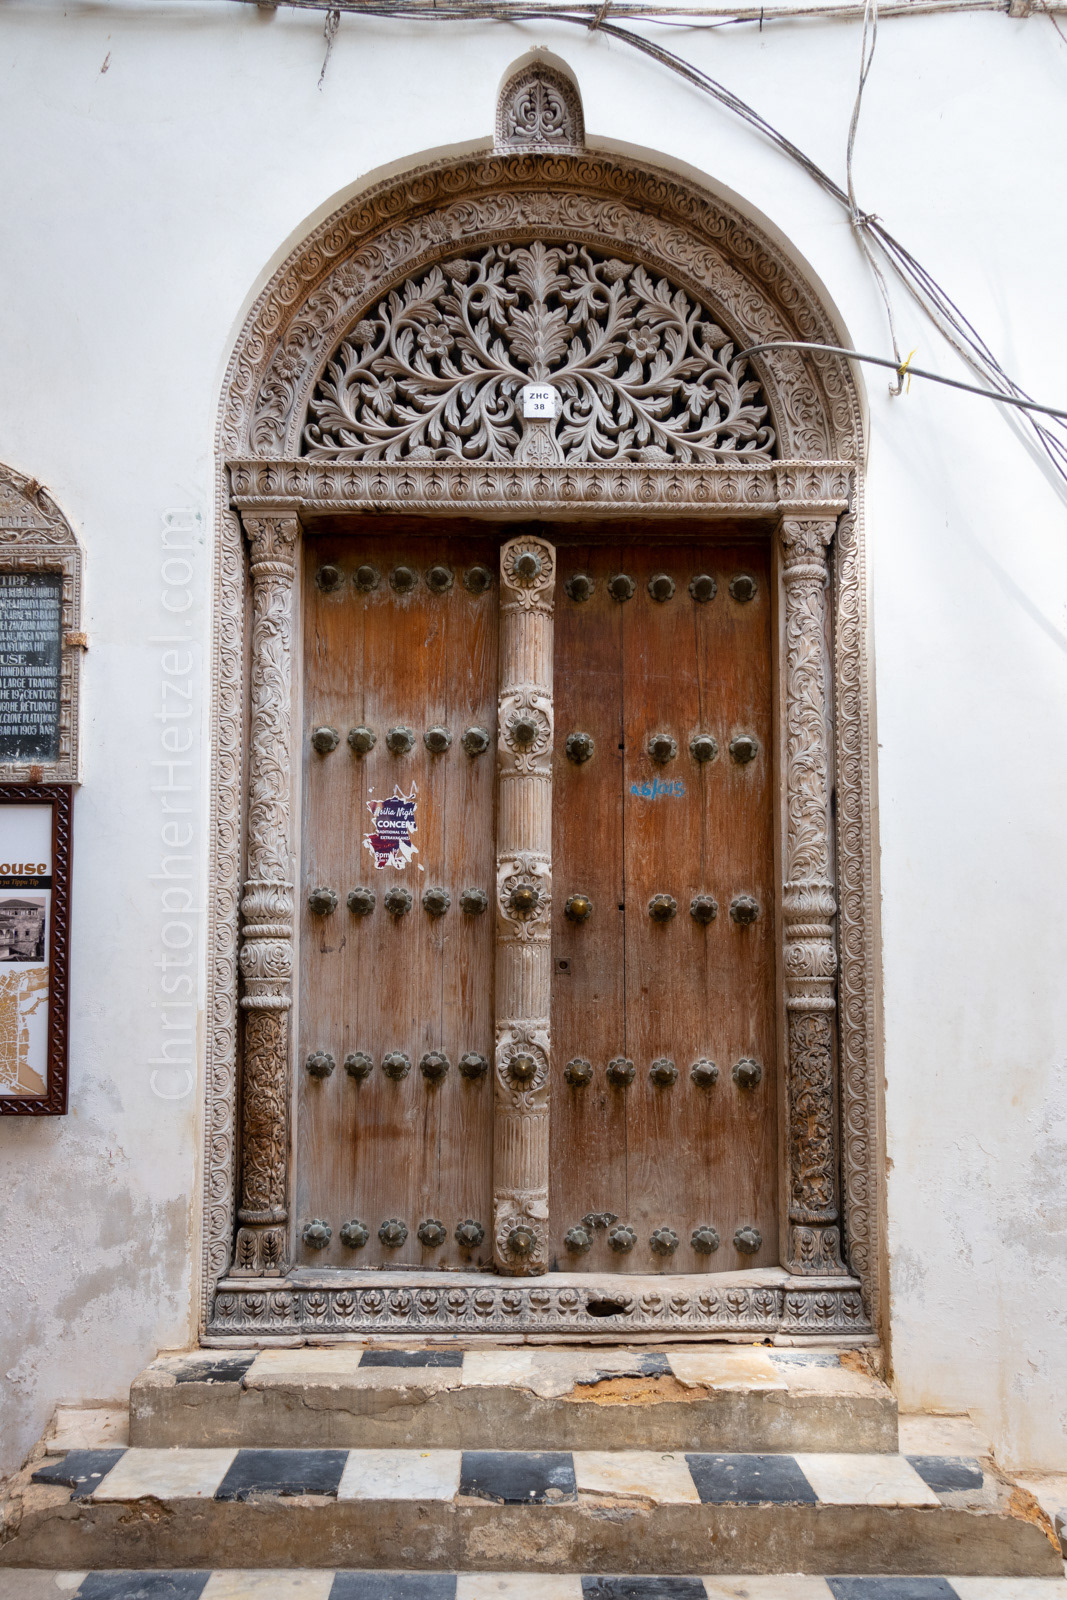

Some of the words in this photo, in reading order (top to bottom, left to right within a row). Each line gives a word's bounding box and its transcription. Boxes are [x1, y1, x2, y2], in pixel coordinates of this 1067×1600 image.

[529, 392, 549, 400] ZHC
[534, 403, 545, 411] 38
[3, 678, 27, 688] LARGE
[28, 678, 58, 688] TRADING
[24, 690, 58, 700] CENTURY
[20, 702, 57, 712] RETURNED
[19, 725, 37, 736] 1905
[0, 862, 47, 875] ouse
[29, 879, 40, 887] Tip
